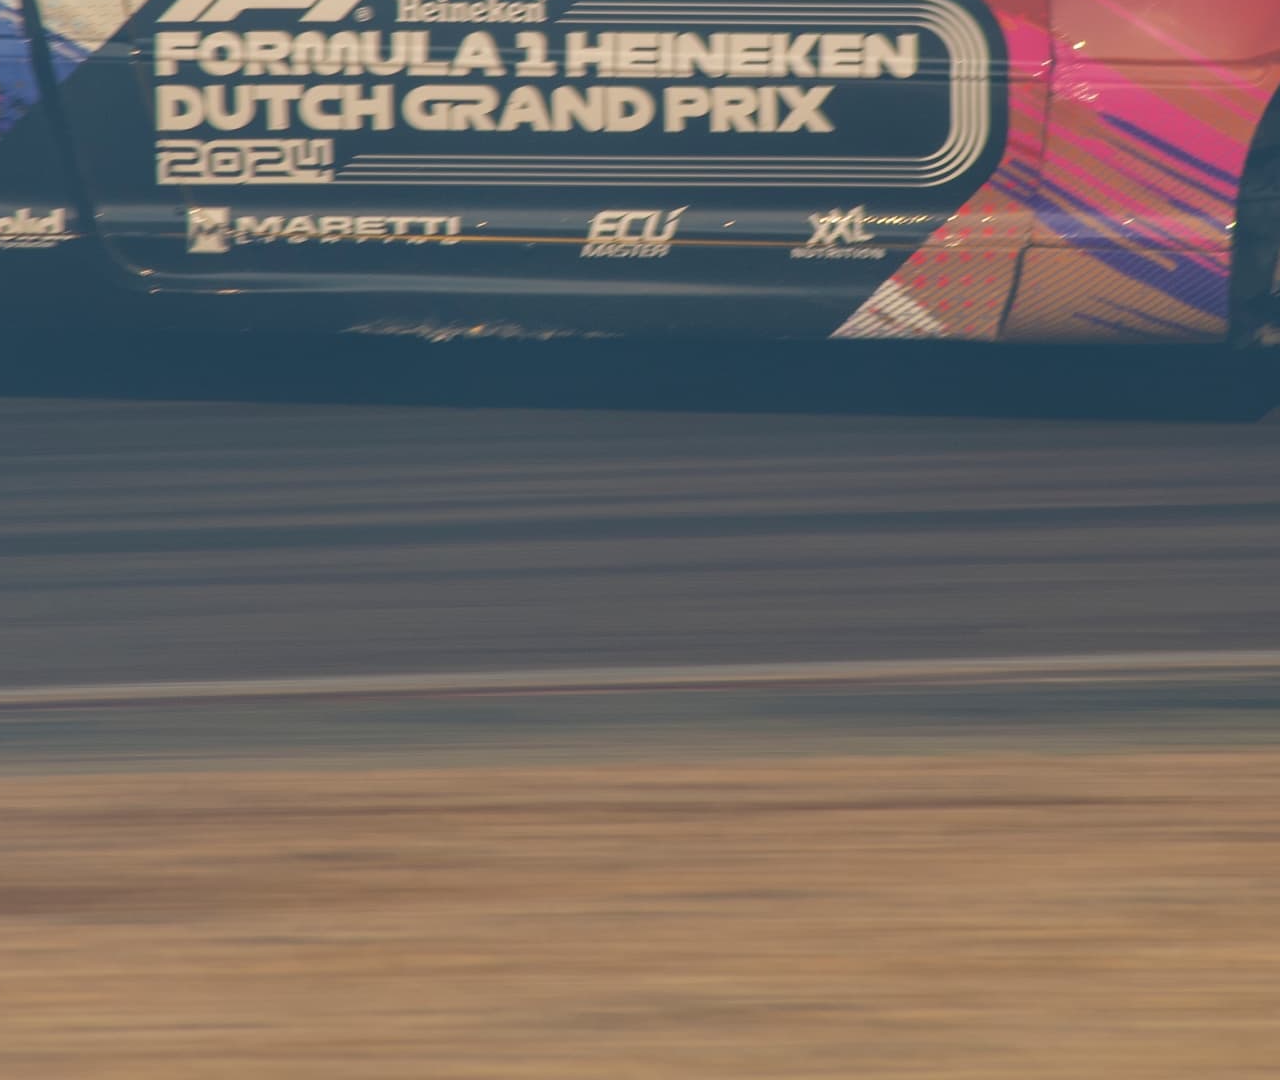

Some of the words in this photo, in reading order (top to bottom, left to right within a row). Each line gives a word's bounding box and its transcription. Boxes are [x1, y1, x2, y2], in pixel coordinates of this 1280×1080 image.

[154, 30, 507, 77] FORMULA
[514, 31, 558, 78] 1
[565, 31, 919, 79] HEINEKEN
[155, 84, 396, 131] DUTCH
[401, 84, 656, 133] GRAND
[663, 85, 837, 134] PRIX
[155, 138, 336, 185] 2024
[234, 215, 462, 236] MARETTI
[586, 205, 690, 241] ECU
